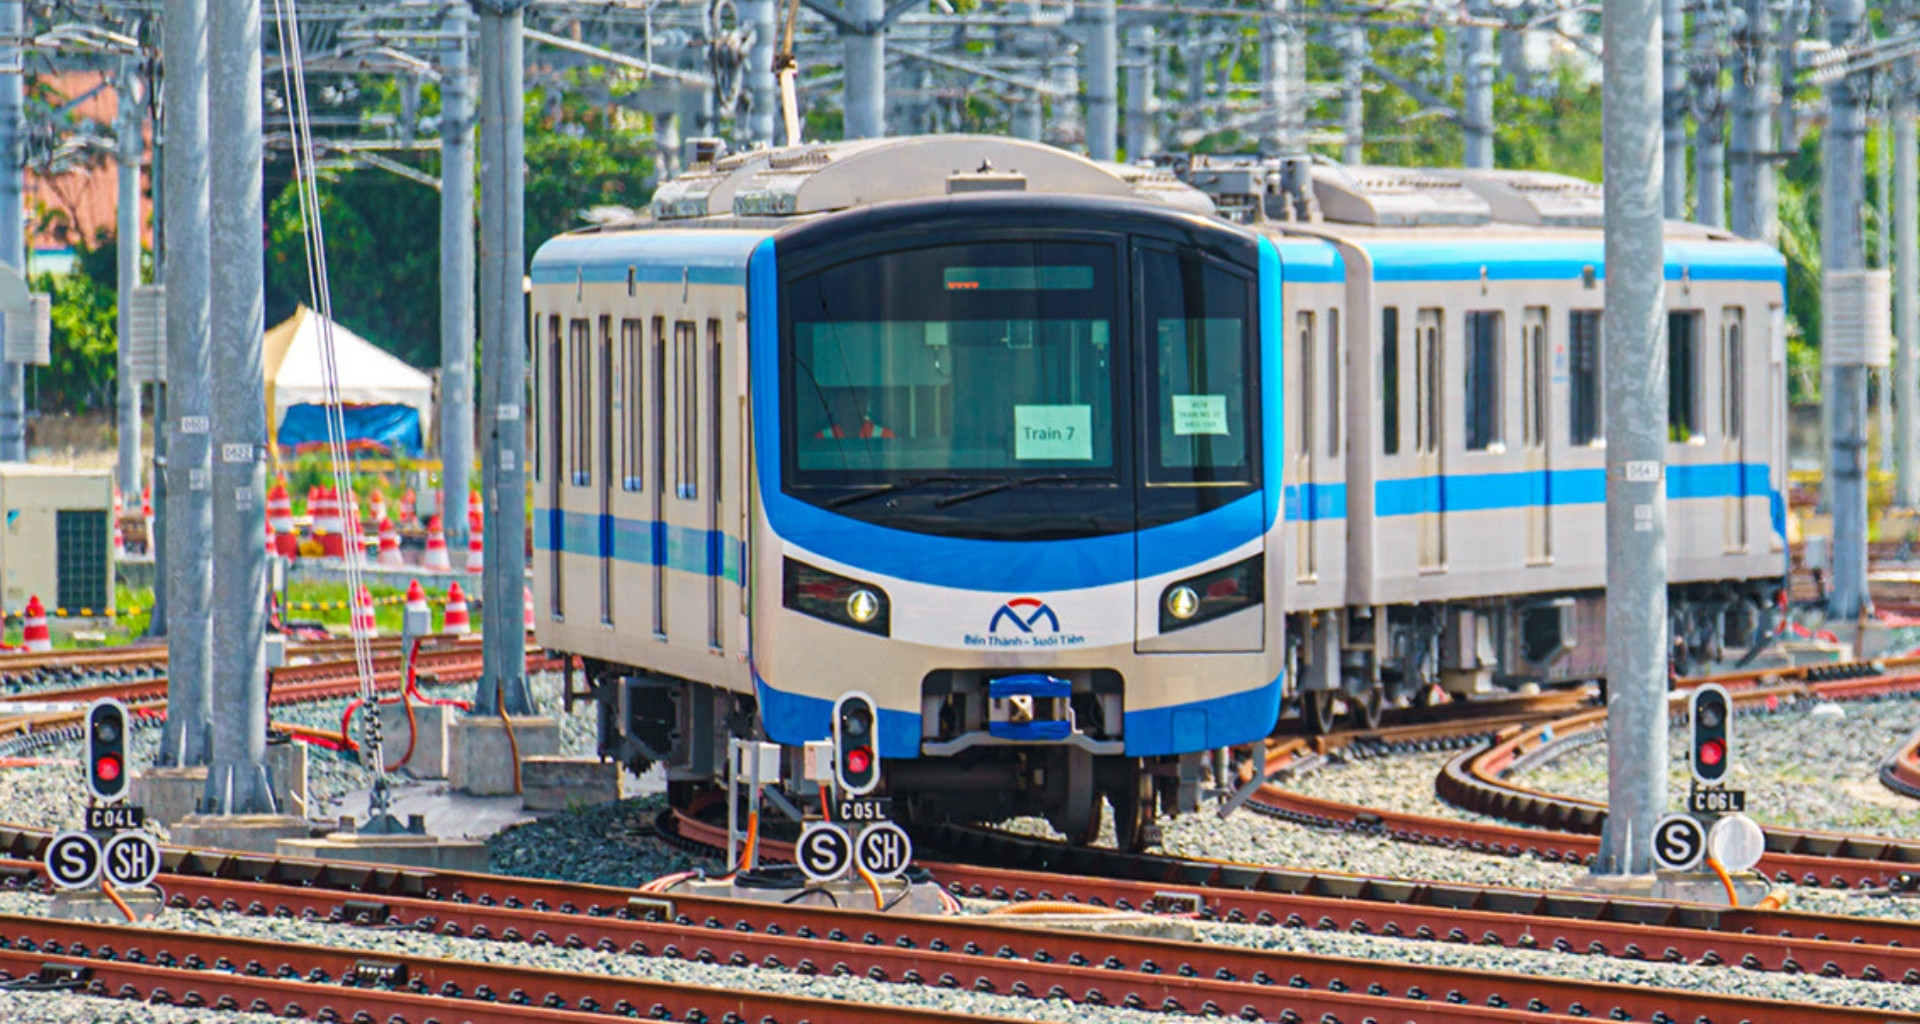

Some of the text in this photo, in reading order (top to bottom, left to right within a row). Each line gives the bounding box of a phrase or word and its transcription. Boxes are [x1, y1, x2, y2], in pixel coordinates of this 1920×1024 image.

[1024, 426, 1075, 441] Train 7
[92, 809, 137, 828] C04L
[841, 802, 886, 820] C05L
[1696, 792, 1739, 810] C06L
[60, 841, 86, 879] S
[115, 842, 147, 879] SH
[811, 833, 837, 871] S
[867, 833, 898, 870] SH
[1665, 824, 1691, 861] S
